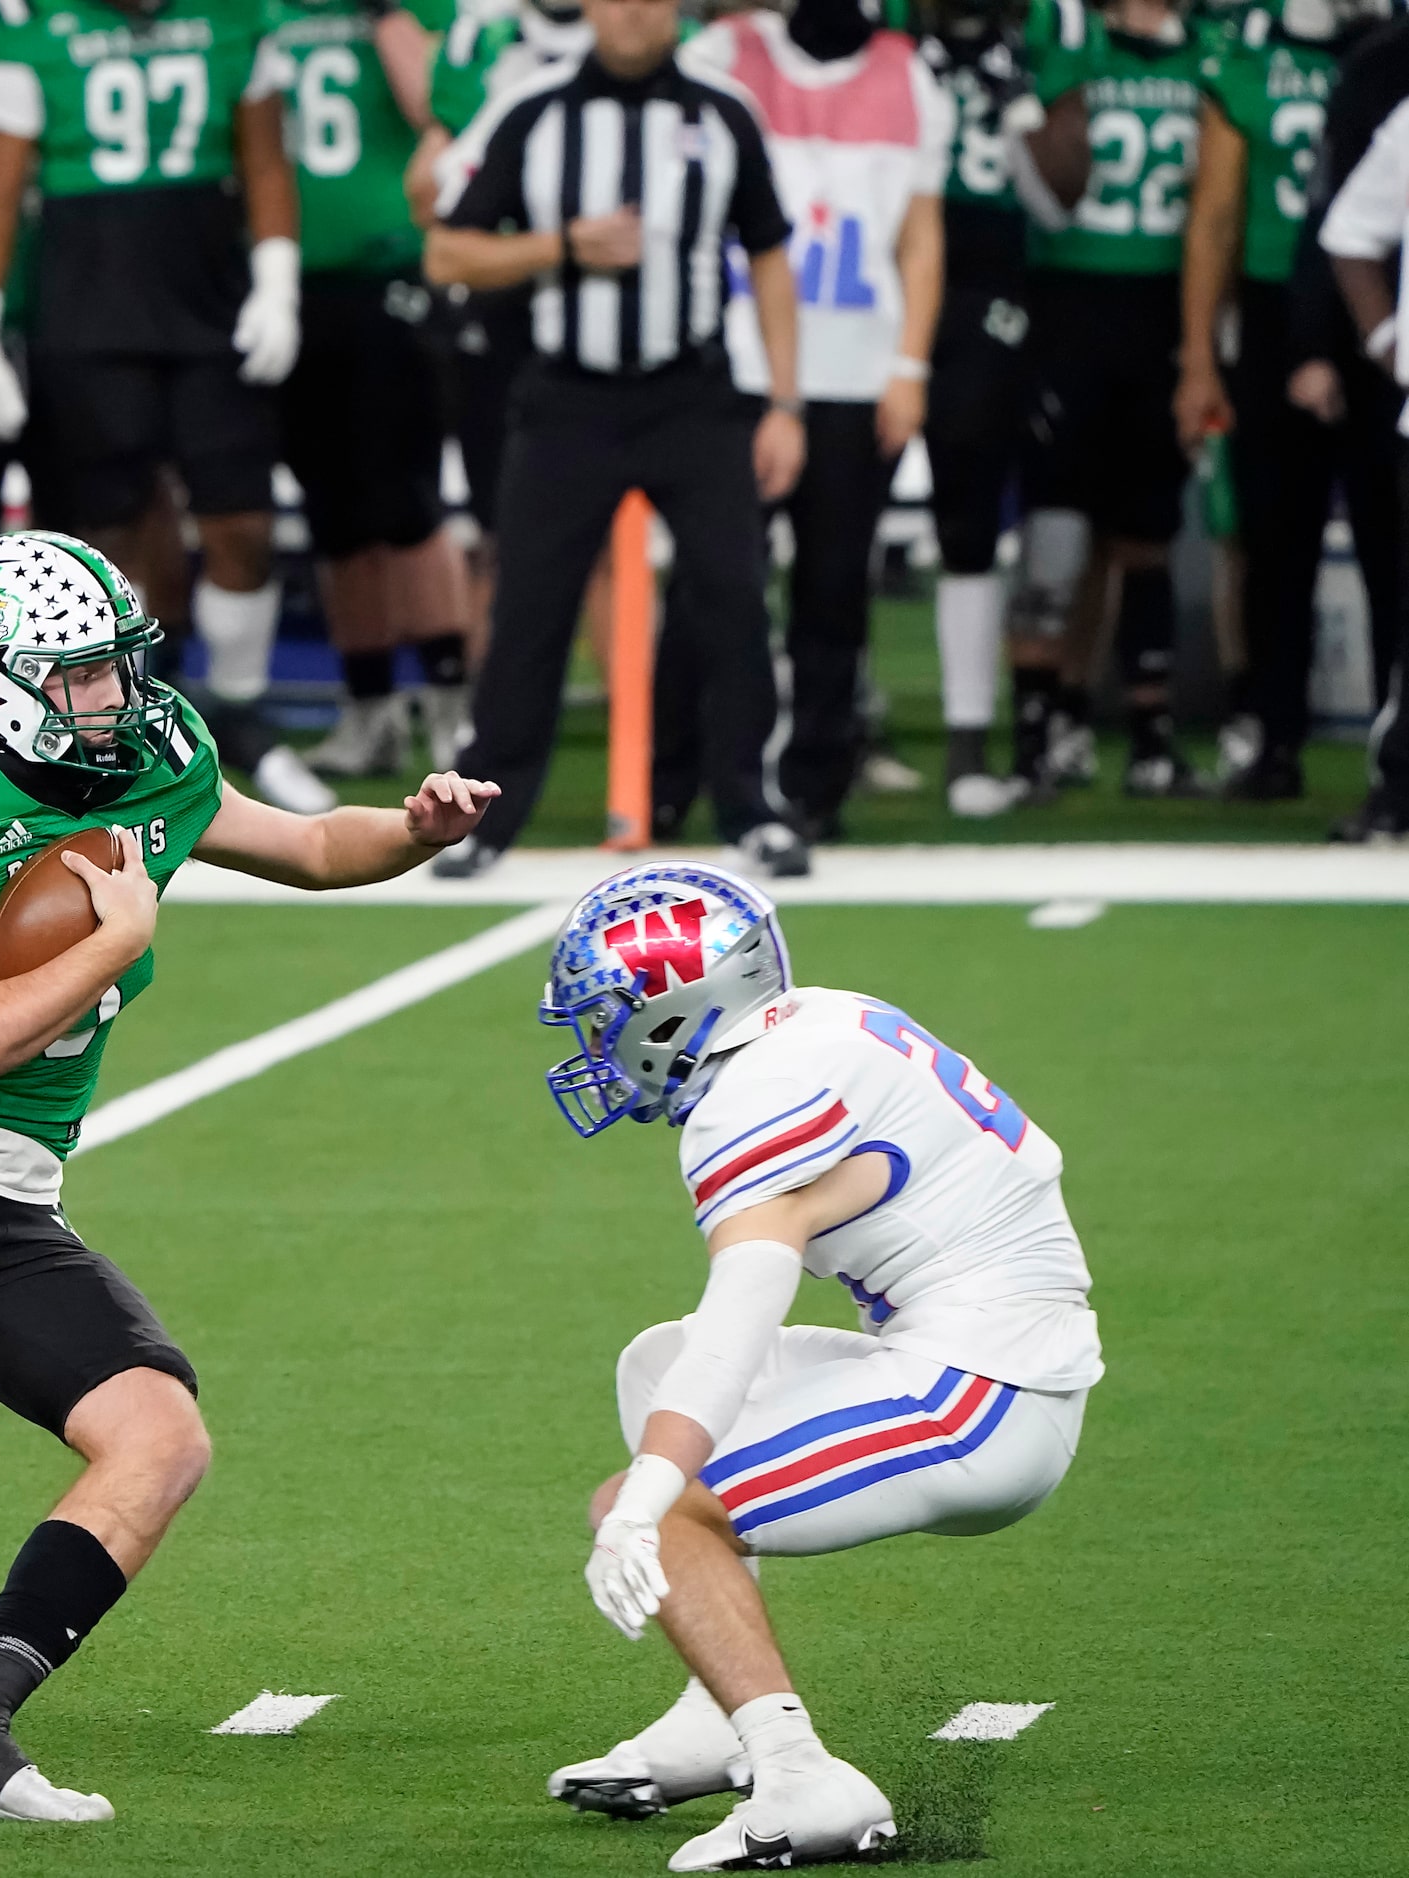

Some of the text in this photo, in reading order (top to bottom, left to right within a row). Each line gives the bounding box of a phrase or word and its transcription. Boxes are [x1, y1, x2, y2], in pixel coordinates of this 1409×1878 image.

[85, 53, 208, 183] 97
[1076, 111, 1200, 235] 22
[603, 898, 708, 998] W
